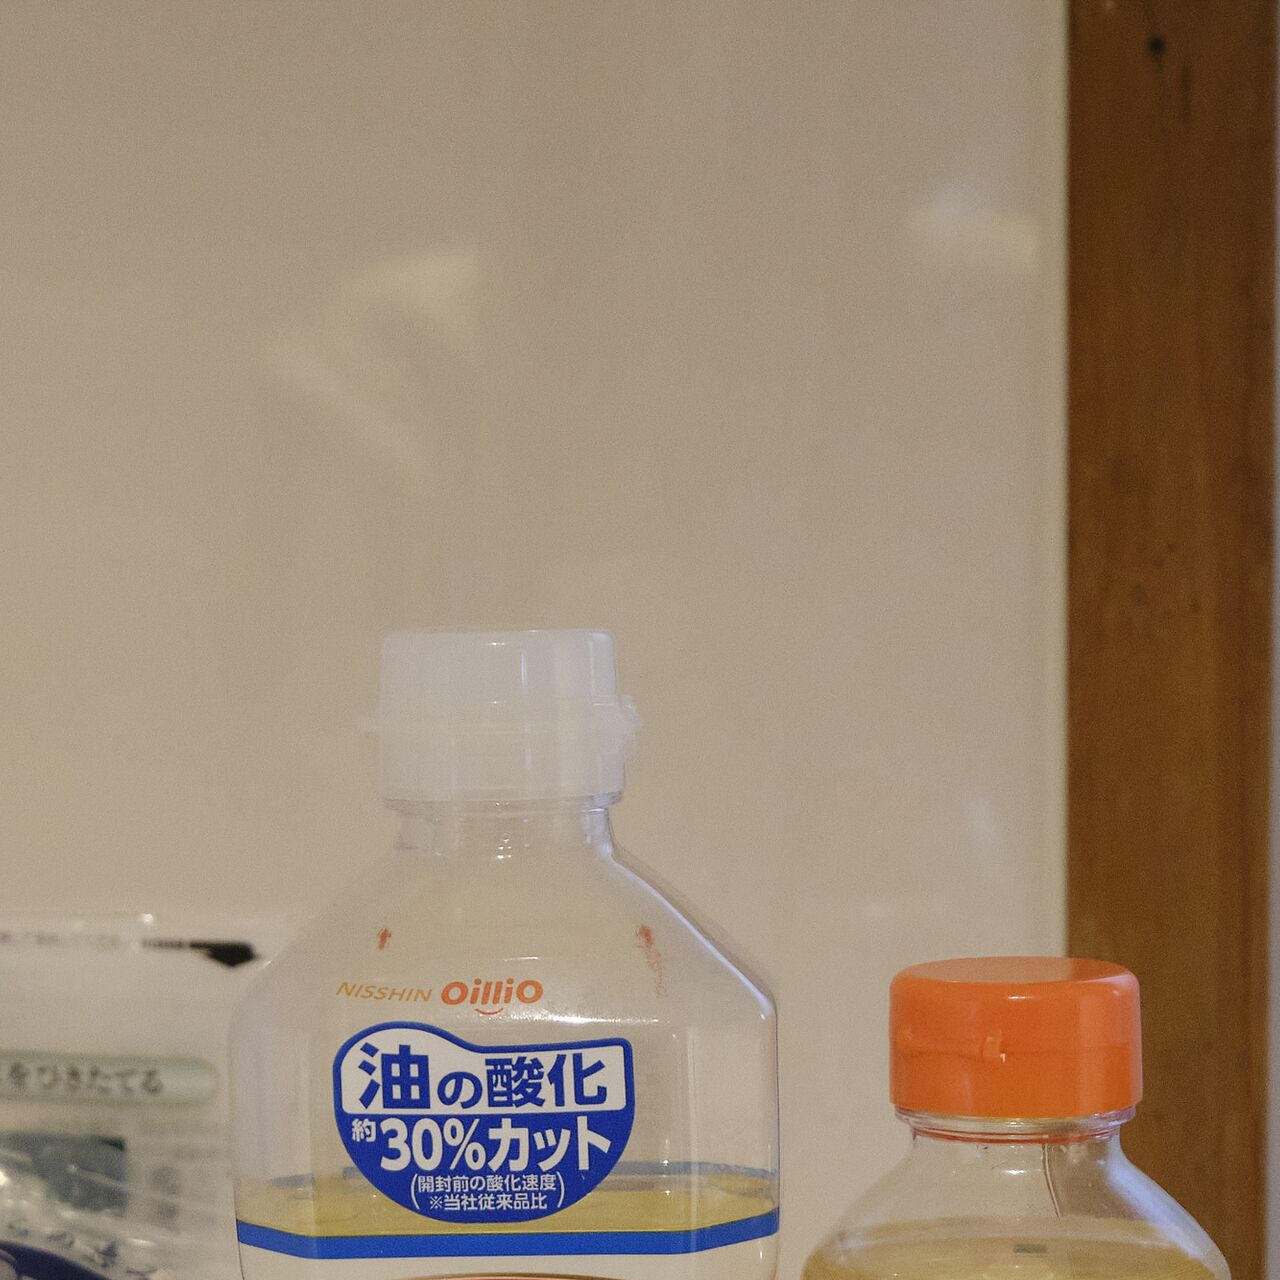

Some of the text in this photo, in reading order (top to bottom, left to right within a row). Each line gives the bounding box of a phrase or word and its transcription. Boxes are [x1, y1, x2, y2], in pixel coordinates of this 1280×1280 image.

[335, 981, 432, 1003] NISSHIN
[357, 1042, 608, 1109] 油の酸化
